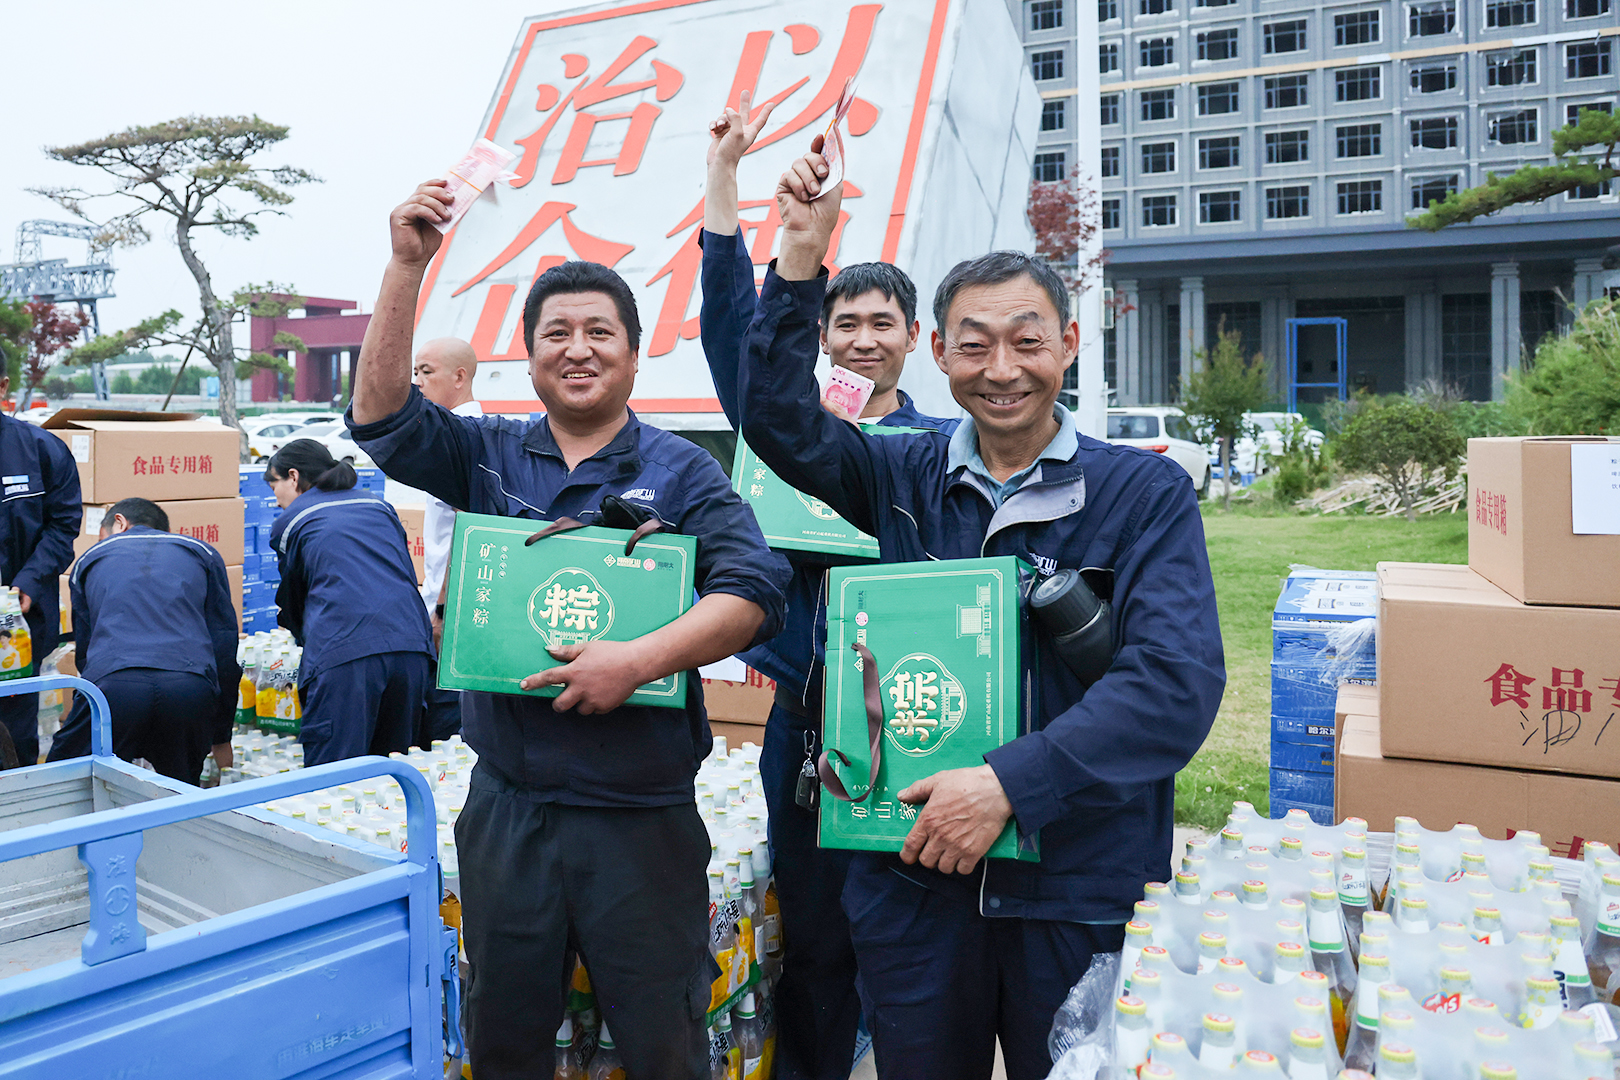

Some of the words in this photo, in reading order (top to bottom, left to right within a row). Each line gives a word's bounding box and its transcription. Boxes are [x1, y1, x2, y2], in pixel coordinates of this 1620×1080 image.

[132, 455, 213, 476] 食品专用箱
[750, 456, 767, 497] 家粽
[1475, 487, 1507, 536] 食品专用箱
[472, 542, 497, 626] 矿山家粽
[539, 582, 601, 631] 粽
[889, 670, 939, 742] 粽
[851, 801, 918, 822] 矿山家
